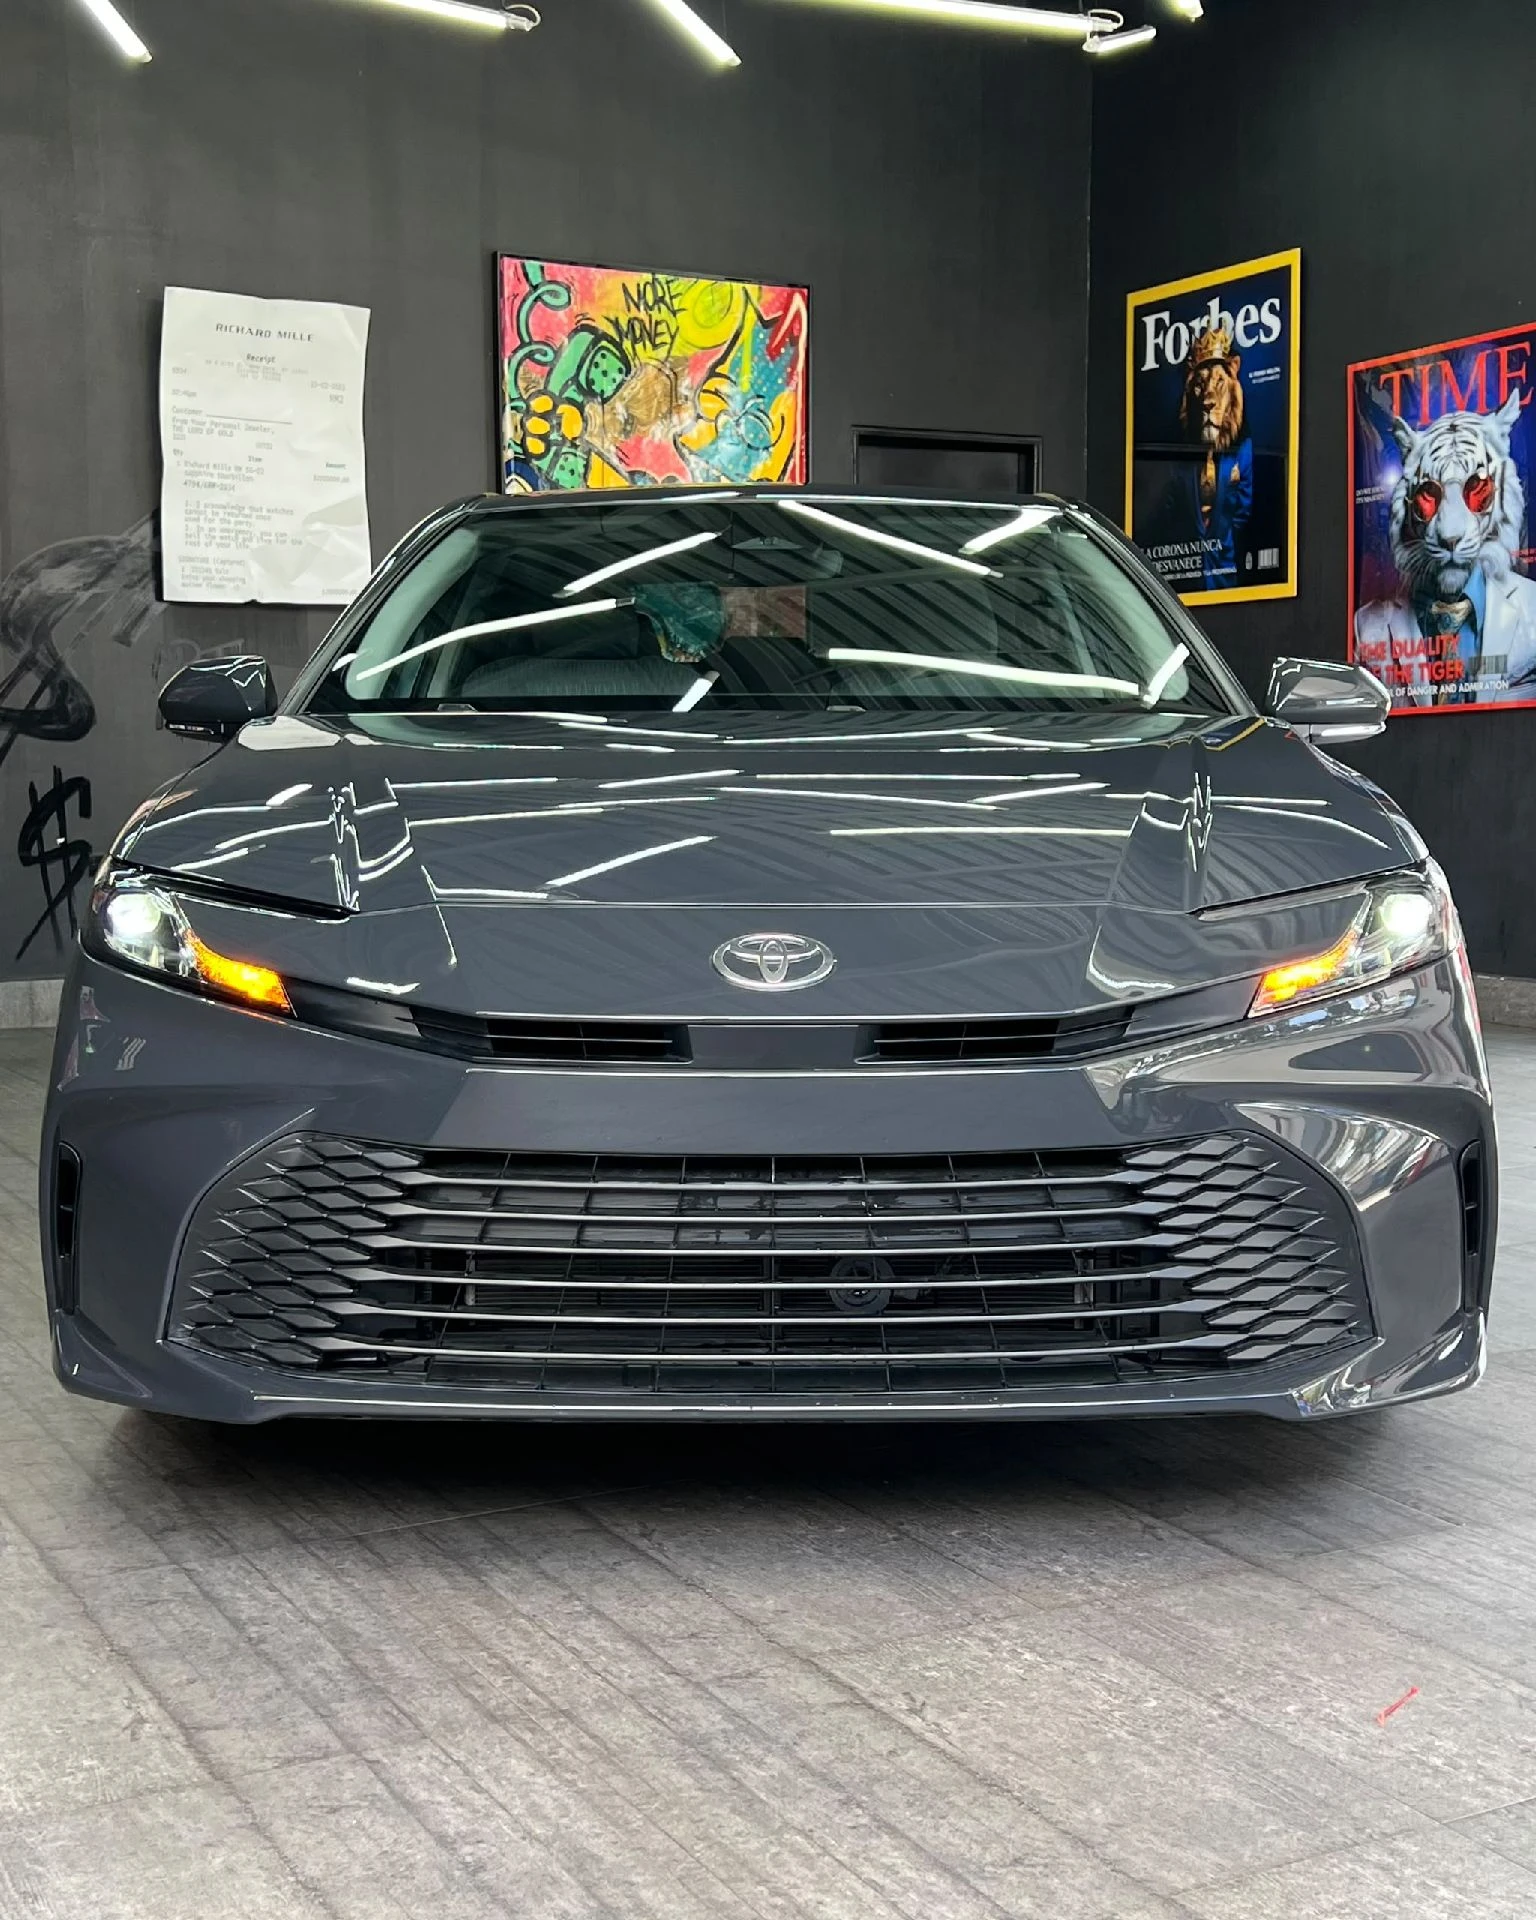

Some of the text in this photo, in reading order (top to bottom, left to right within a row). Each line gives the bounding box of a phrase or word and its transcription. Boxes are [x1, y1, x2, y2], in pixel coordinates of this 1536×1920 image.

[215, 323, 314, 343] RICHARD MILLE
[602, 314, 680, 364] MONEY
[1140, 296, 1282, 372] Forbes
[246, 353, 276, 364] Receipt
[1379, 341, 1534, 426] TIME
[172, 405, 203, 415] Customer
[209, 420, 240, 430] Personal
[184, 460, 210, 470] Richard
[1152, 543, 1189, 558] CORONA
[1190, 538, 1223, 553] NUNCA
[1359, 634, 1461, 661] THE DUALITY
[1385, 664, 1414, 686] THE
[1418, 658, 1465, 683] TIGER
[1395, 686, 1406, 696] OF
[1407, 684, 1438, 696] DANGER
[1439, 683, 1457, 693] AND
[1458, 679, 1510, 692] ADMIRATION
